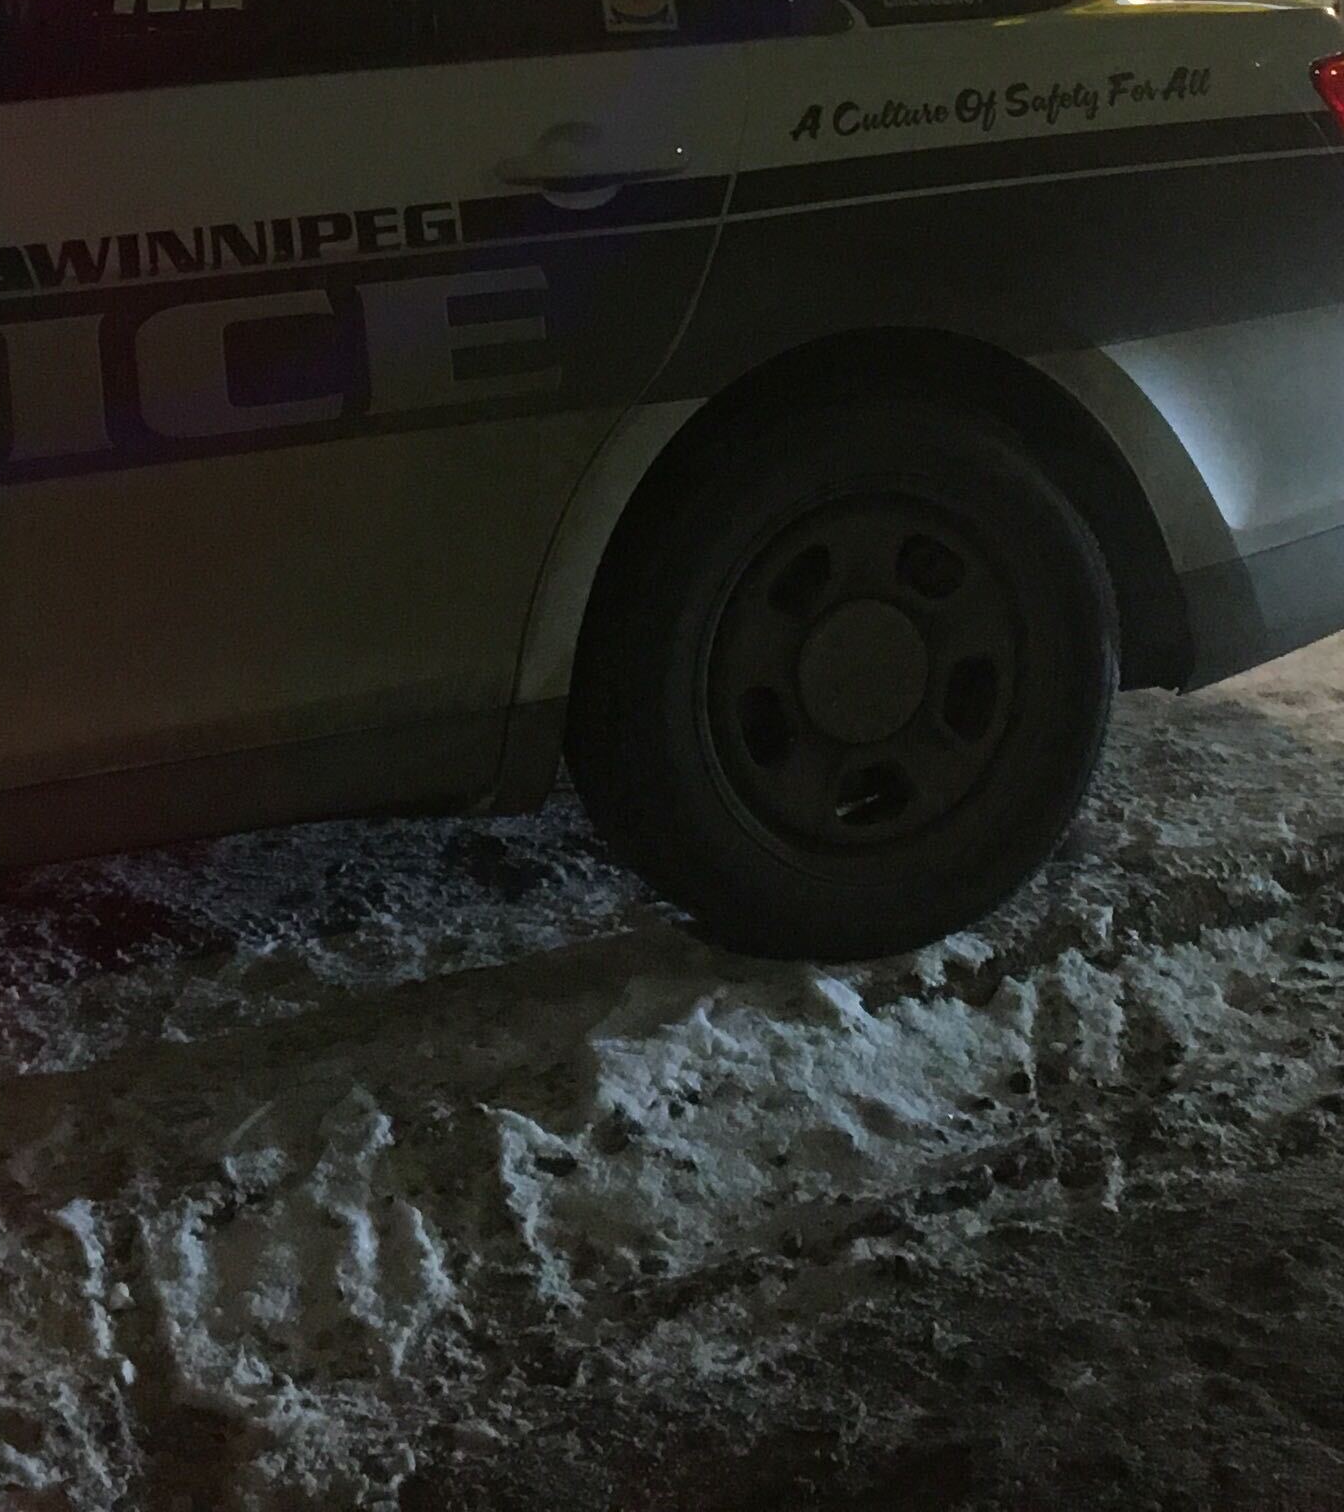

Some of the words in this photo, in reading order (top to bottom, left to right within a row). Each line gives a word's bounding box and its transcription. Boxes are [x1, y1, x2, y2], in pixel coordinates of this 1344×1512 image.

[790, 104, 823, 141] A
[832, 99, 950, 137] Culture
[955, 88, 997, 132] Of
[1005, 82, 1100, 120] Safety
[1108, 71, 1154, 107] For
[1161, 66, 1212, 100] All
[23, 202, 460, 285] WINNIPEG
